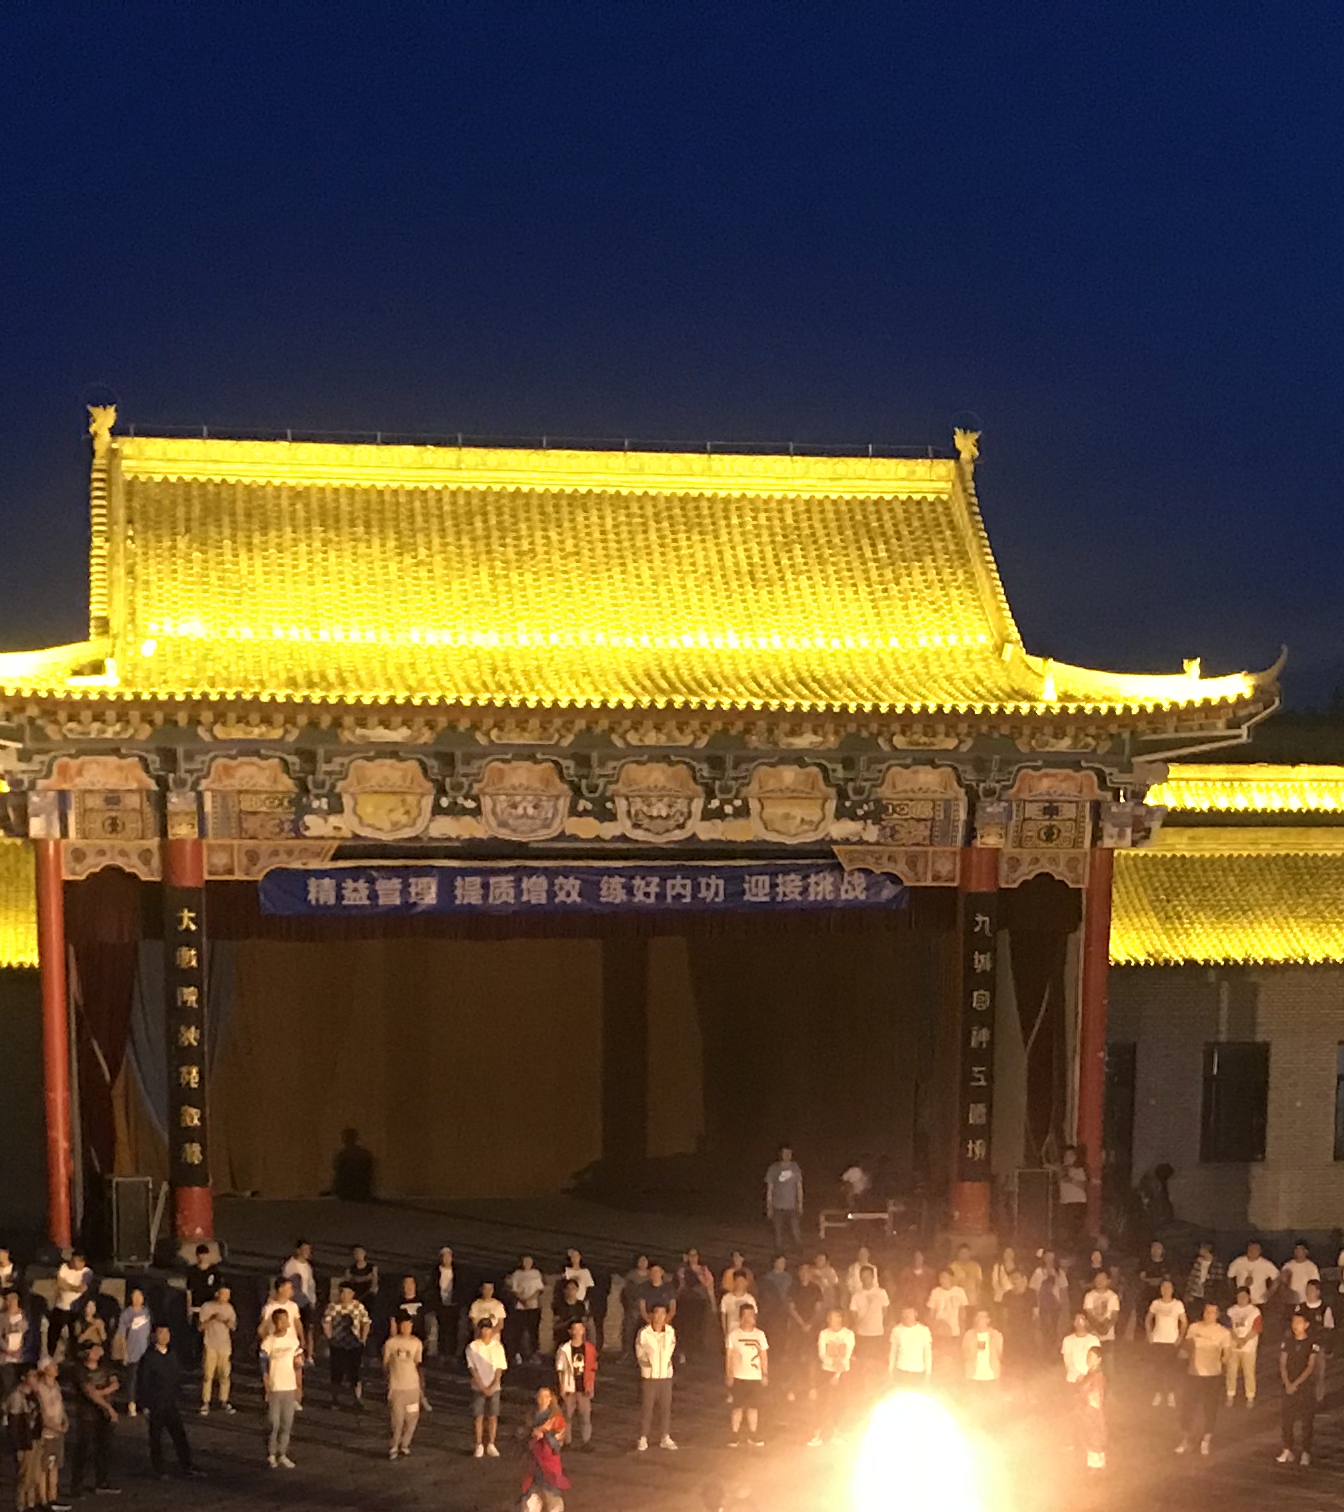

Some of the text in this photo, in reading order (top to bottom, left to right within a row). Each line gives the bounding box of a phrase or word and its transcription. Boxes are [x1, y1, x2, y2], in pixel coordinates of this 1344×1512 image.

[307, 873, 868, 905] 精益管理 提质增效 练好内功 迎接挑战
